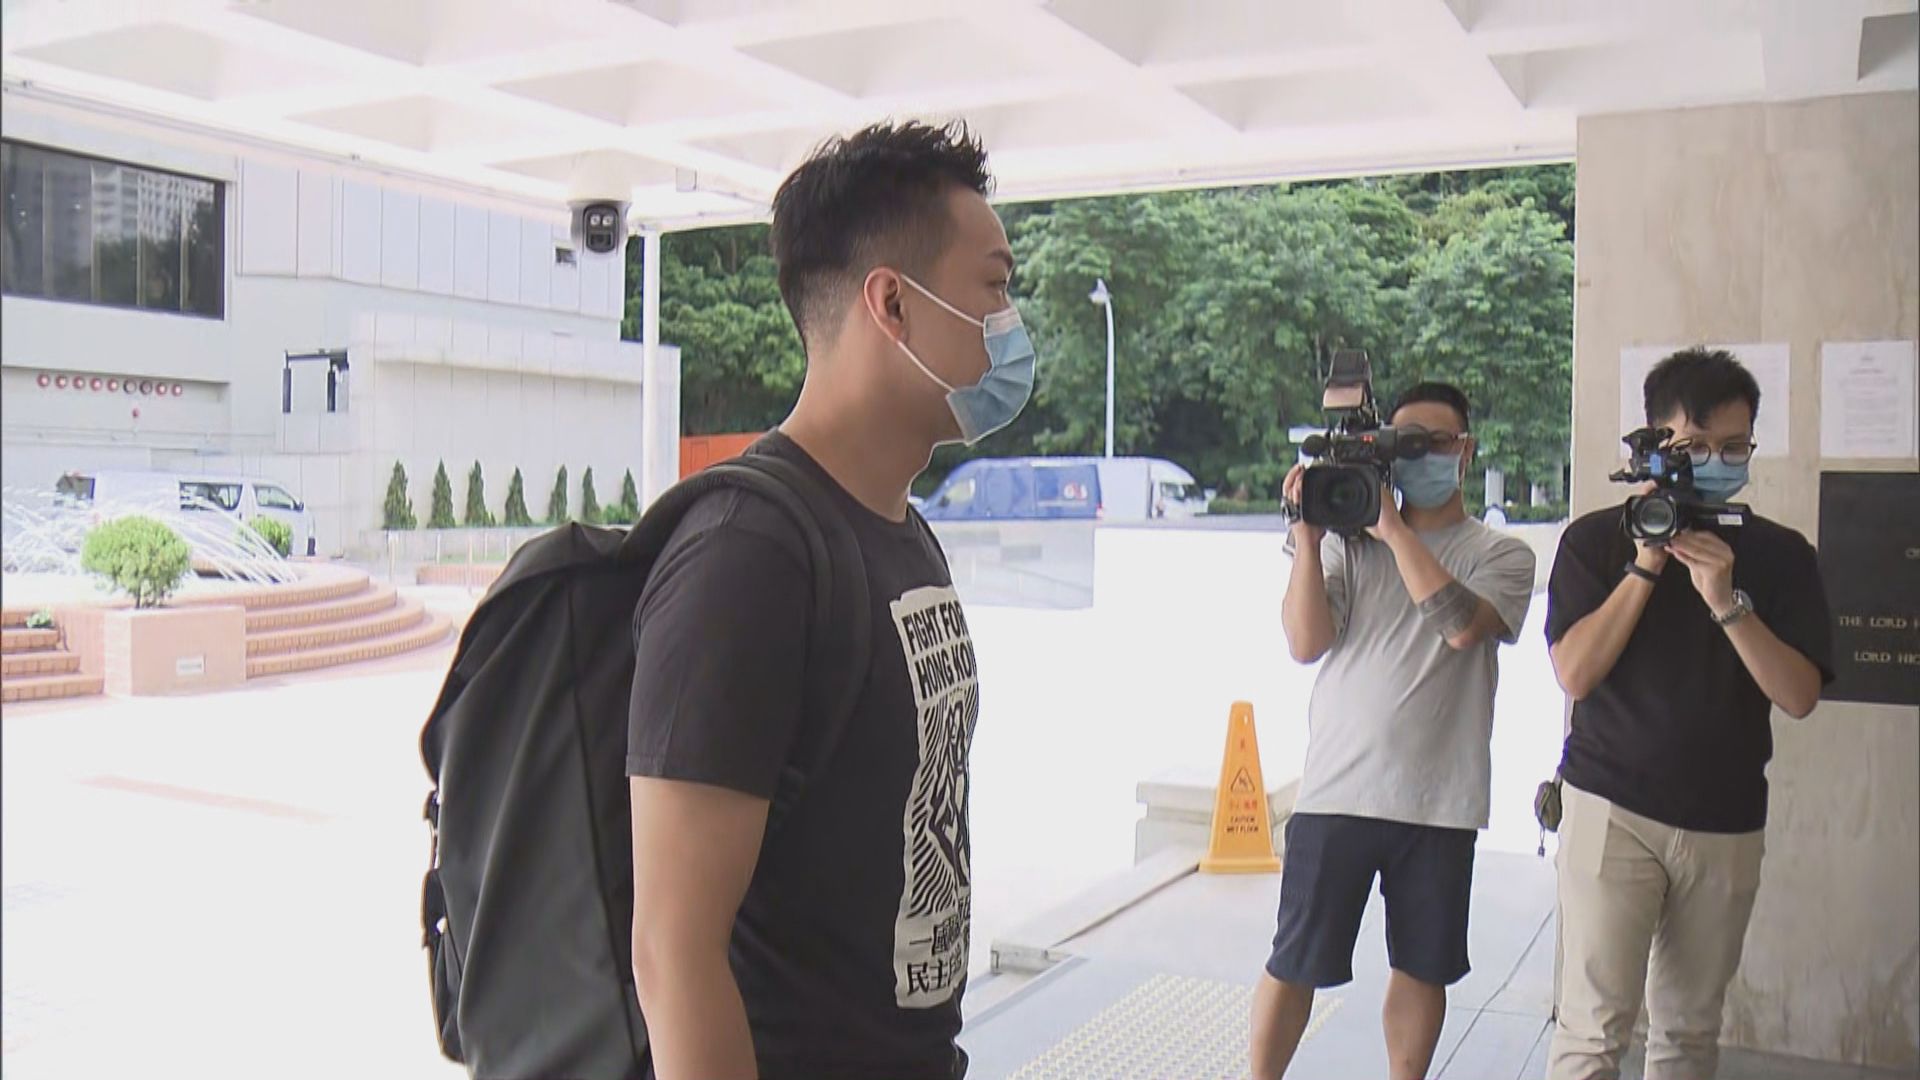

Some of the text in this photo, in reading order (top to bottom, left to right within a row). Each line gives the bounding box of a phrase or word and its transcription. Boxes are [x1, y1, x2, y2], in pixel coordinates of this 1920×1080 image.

[902, 600, 968, 655] FIGHT FOR
[1839, 615, 1862, 627] THE
[1869, 617, 1907, 629] LORD
[1854, 651, 1891, 663] LORD
[915, 648, 956, 700] HONG
